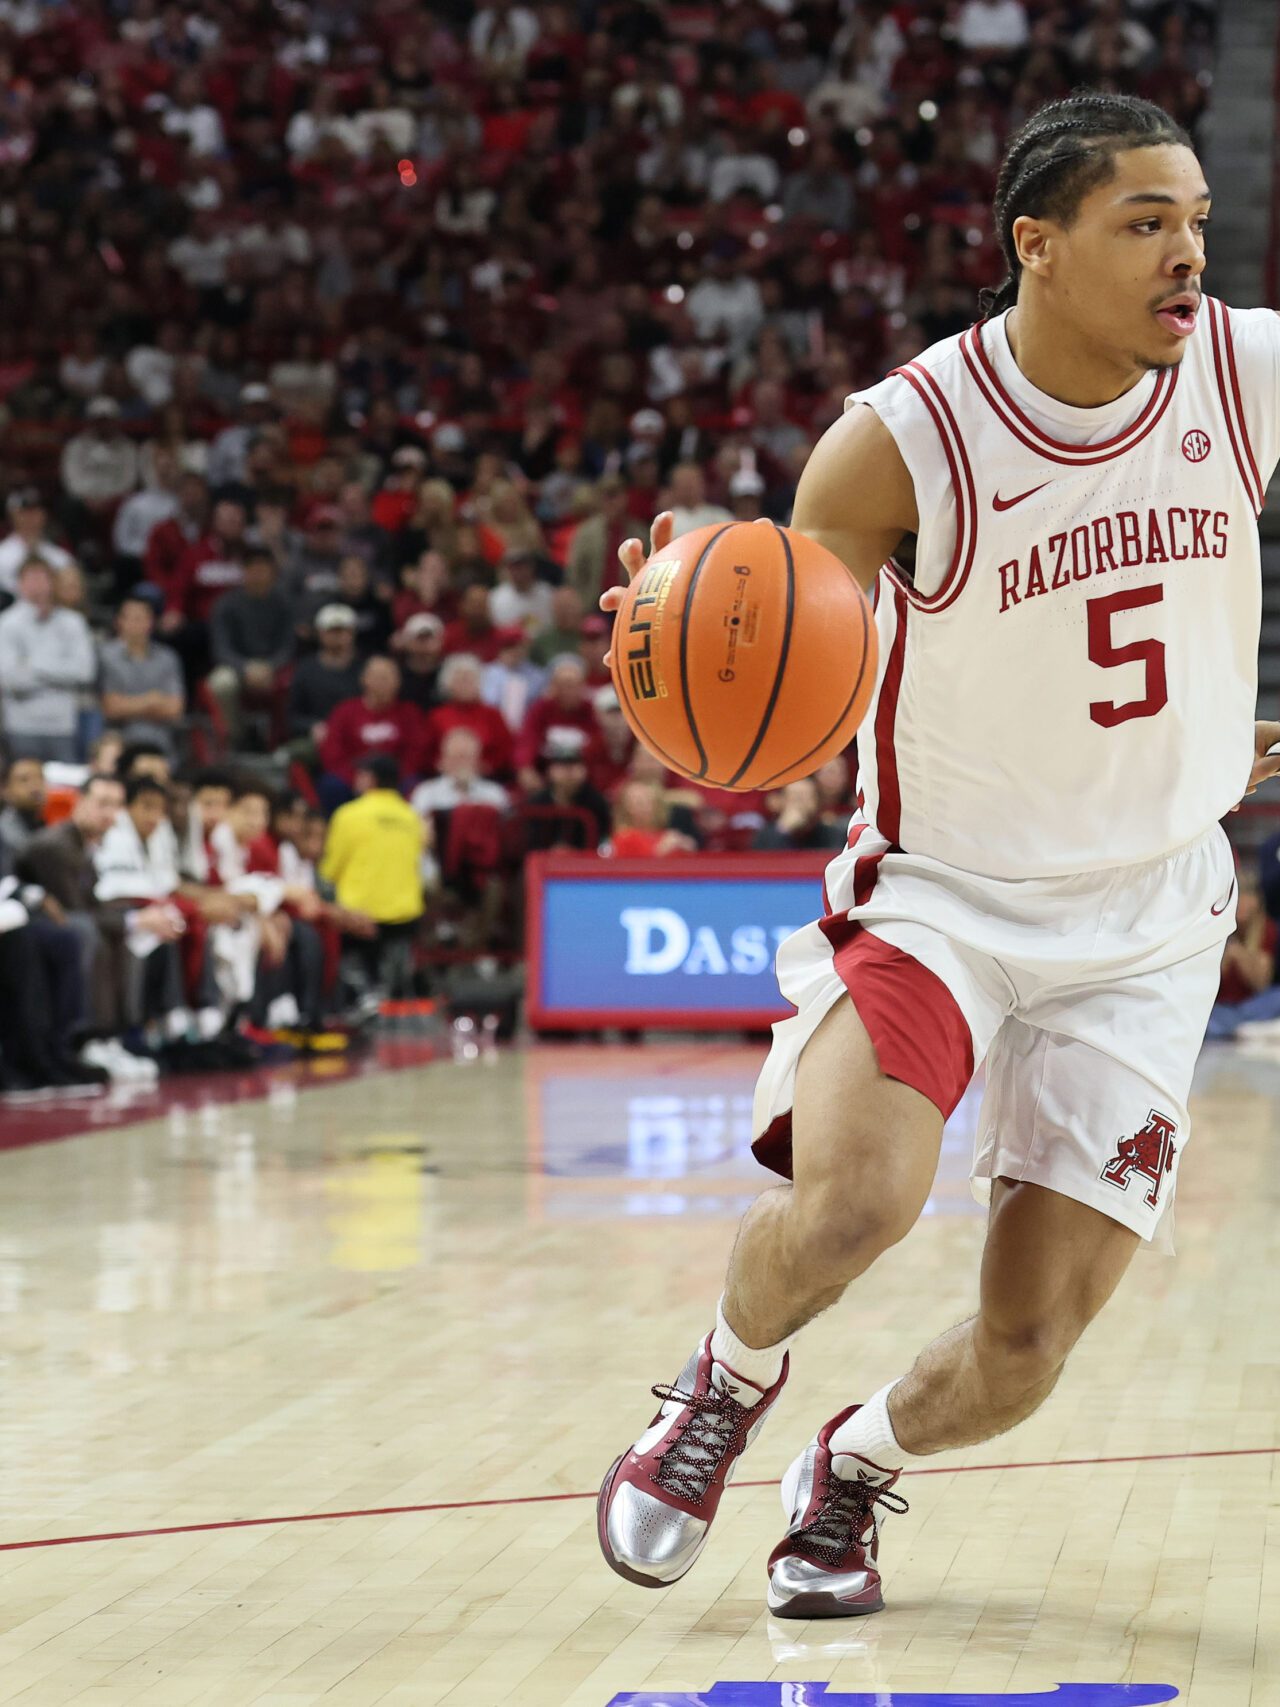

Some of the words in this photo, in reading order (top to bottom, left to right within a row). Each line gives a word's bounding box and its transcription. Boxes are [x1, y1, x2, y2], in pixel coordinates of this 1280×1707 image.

[1182, 430, 1211, 461] SEC
[998, 507, 1229, 614] RAZORBACKS
[628, 559, 675, 700] ELITE
[1086, 583, 1168, 728] 5
[619, 906, 800, 975] DAS
